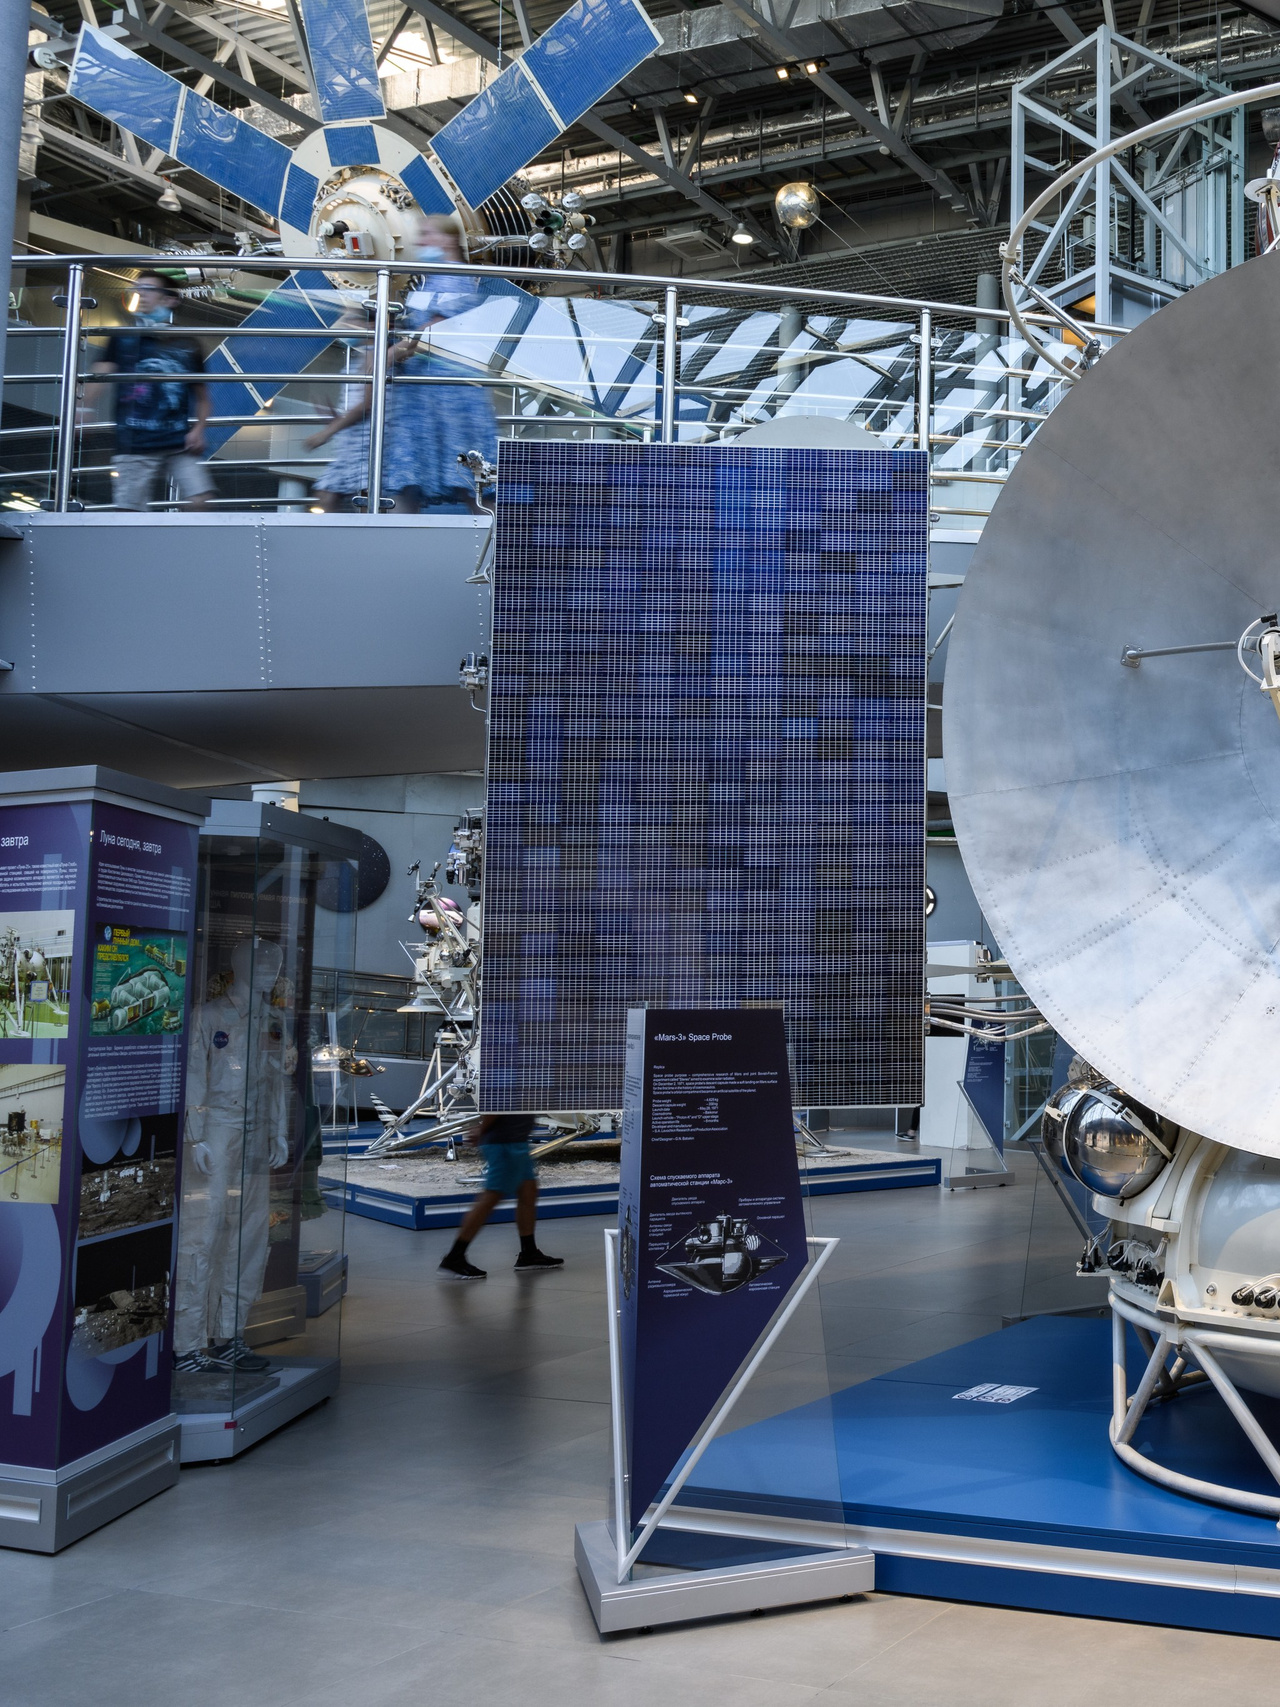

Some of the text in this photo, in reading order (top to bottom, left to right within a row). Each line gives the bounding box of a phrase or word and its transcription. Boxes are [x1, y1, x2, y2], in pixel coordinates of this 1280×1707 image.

[0, 835, 29, 849] завтра
[99, 829, 162, 856] Луна сегодня, завтра
[654, 1033, 732, 1042] «Mars-3» Space Probe
